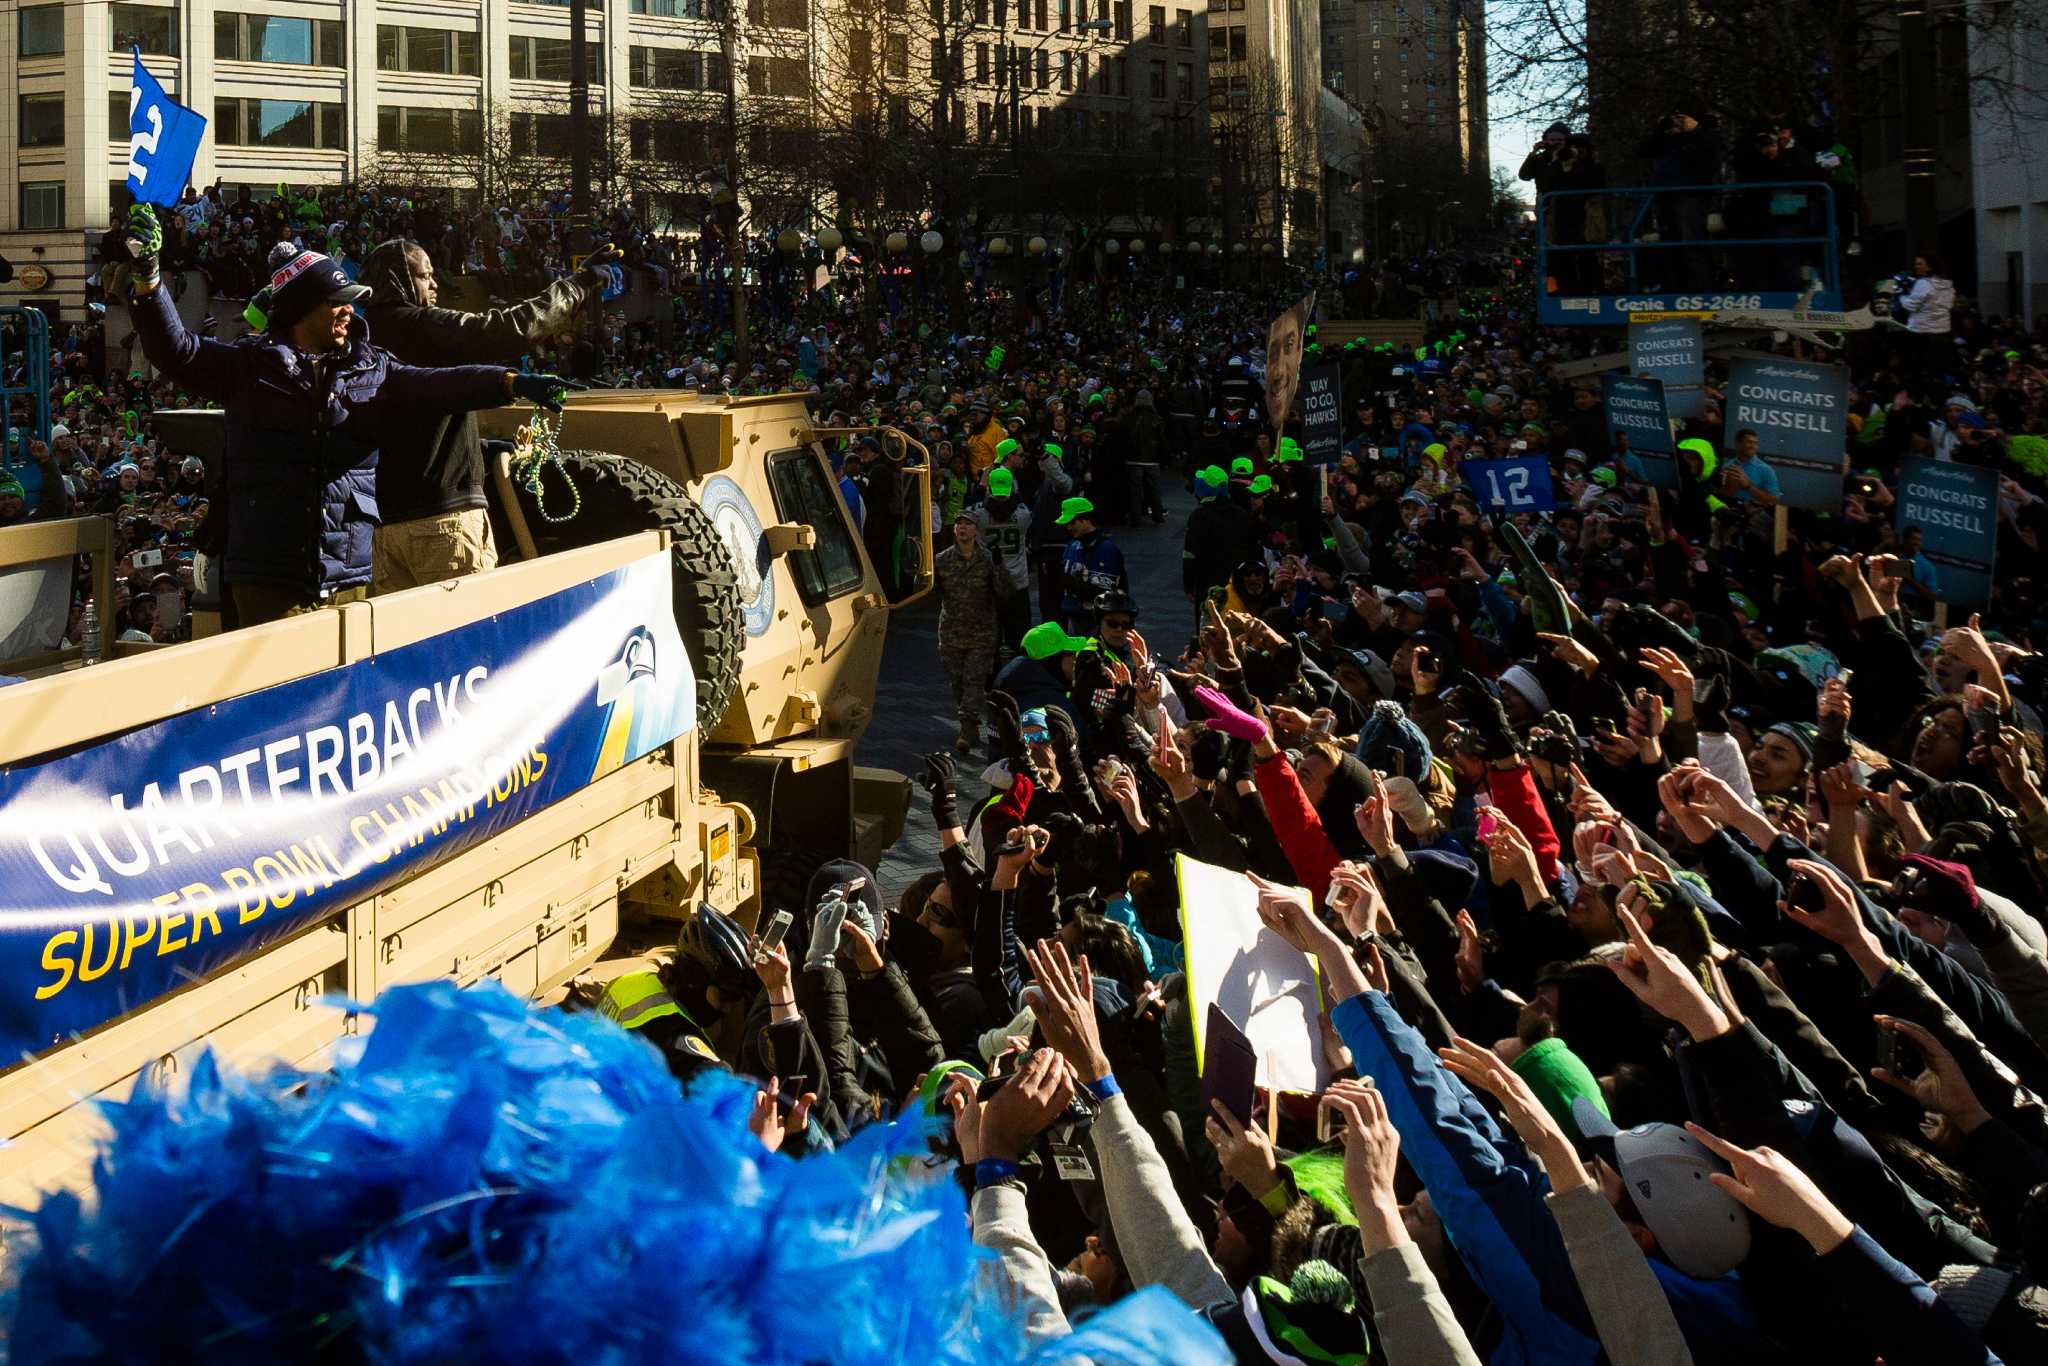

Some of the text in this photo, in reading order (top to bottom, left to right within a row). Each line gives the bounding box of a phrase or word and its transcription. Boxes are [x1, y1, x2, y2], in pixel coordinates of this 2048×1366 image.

[1615, 297, 1664, 311] Genie
[1675, 295, 1761, 310] GS-2646
[1636, 338, 1695, 351] CONGRATS
[1637, 353, 1696, 368] RUSSELL
[1310, 378, 1329, 393] WAY
[1305, 393, 1336, 410] TO GO,
[1609, 396, 1661, 412] CONGRATS
[1739, 385, 1836, 408] CONGRATS
[1305, 408, 1338, 426] HAWKS!
[1612, 411, 1665, 431] RUSSELL
[1738, 405, 1833, 433] RUSSELL
[1485, 466, 1536, 506] 12
[1906, 483, 1987, 510] CONGRATS
[1904, 503, 1985, 536] RUSSELL
[27, 665, 490, 896] QUARTERBACKS
[35, 737, 549, 1000] SUPER BOWL CHAMPIONS
